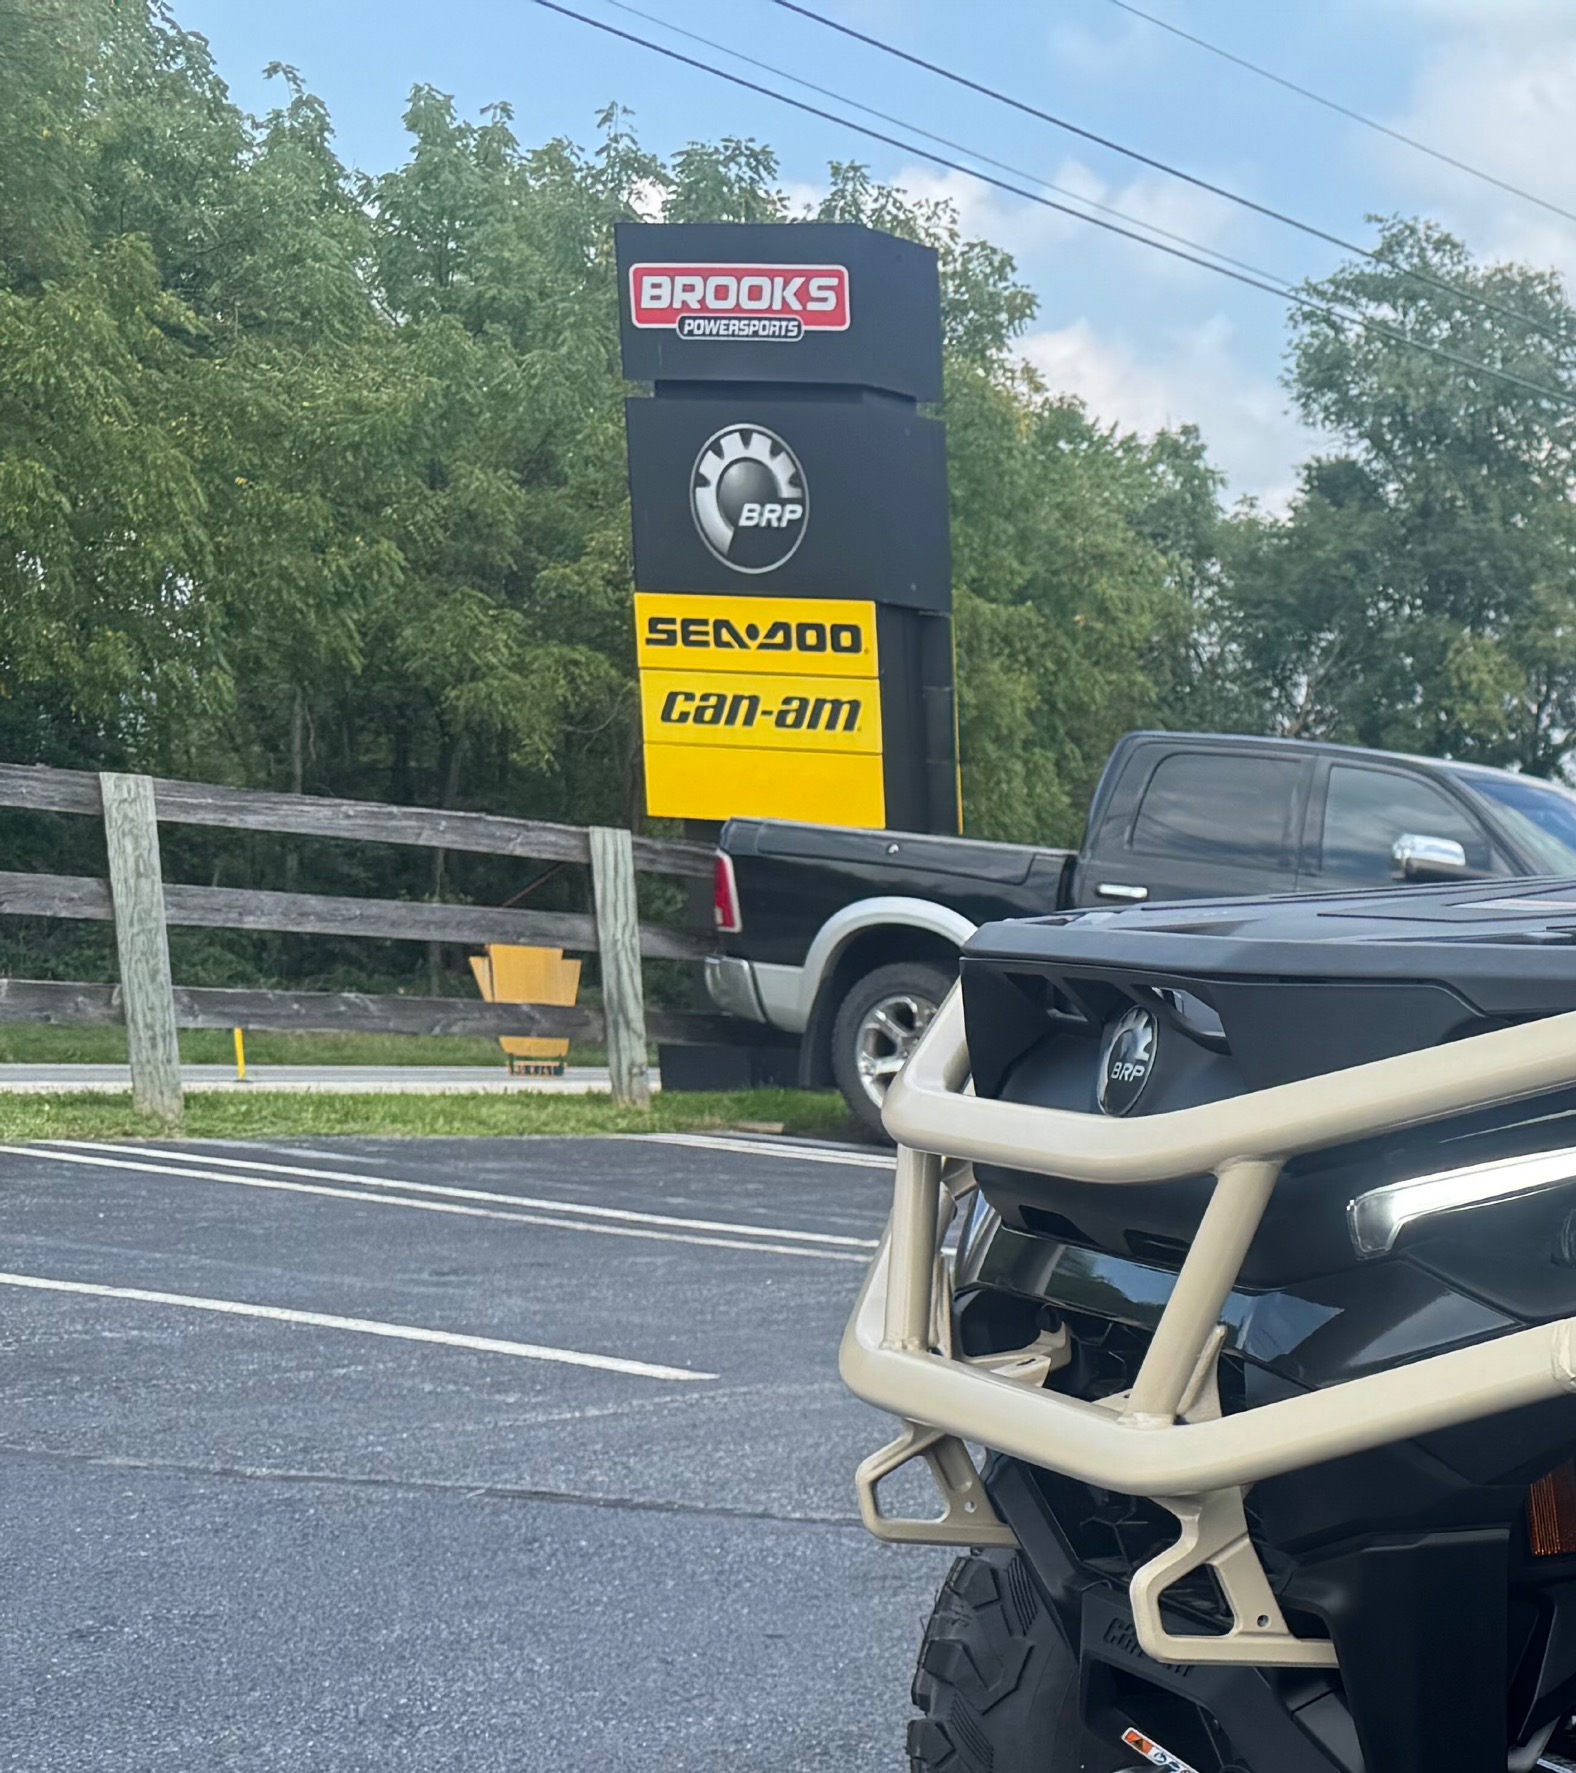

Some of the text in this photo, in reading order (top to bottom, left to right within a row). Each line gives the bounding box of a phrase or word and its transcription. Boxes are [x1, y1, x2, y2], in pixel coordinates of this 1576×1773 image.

[639, 274, 840, 313] BROOKS
[682, 317, 800, 339] POWERSPORTS
[738, 502, 804, 529] BRP
[660, 688, 862, 733] can-am
[1110, 1061, 1146, 1083] BRP
